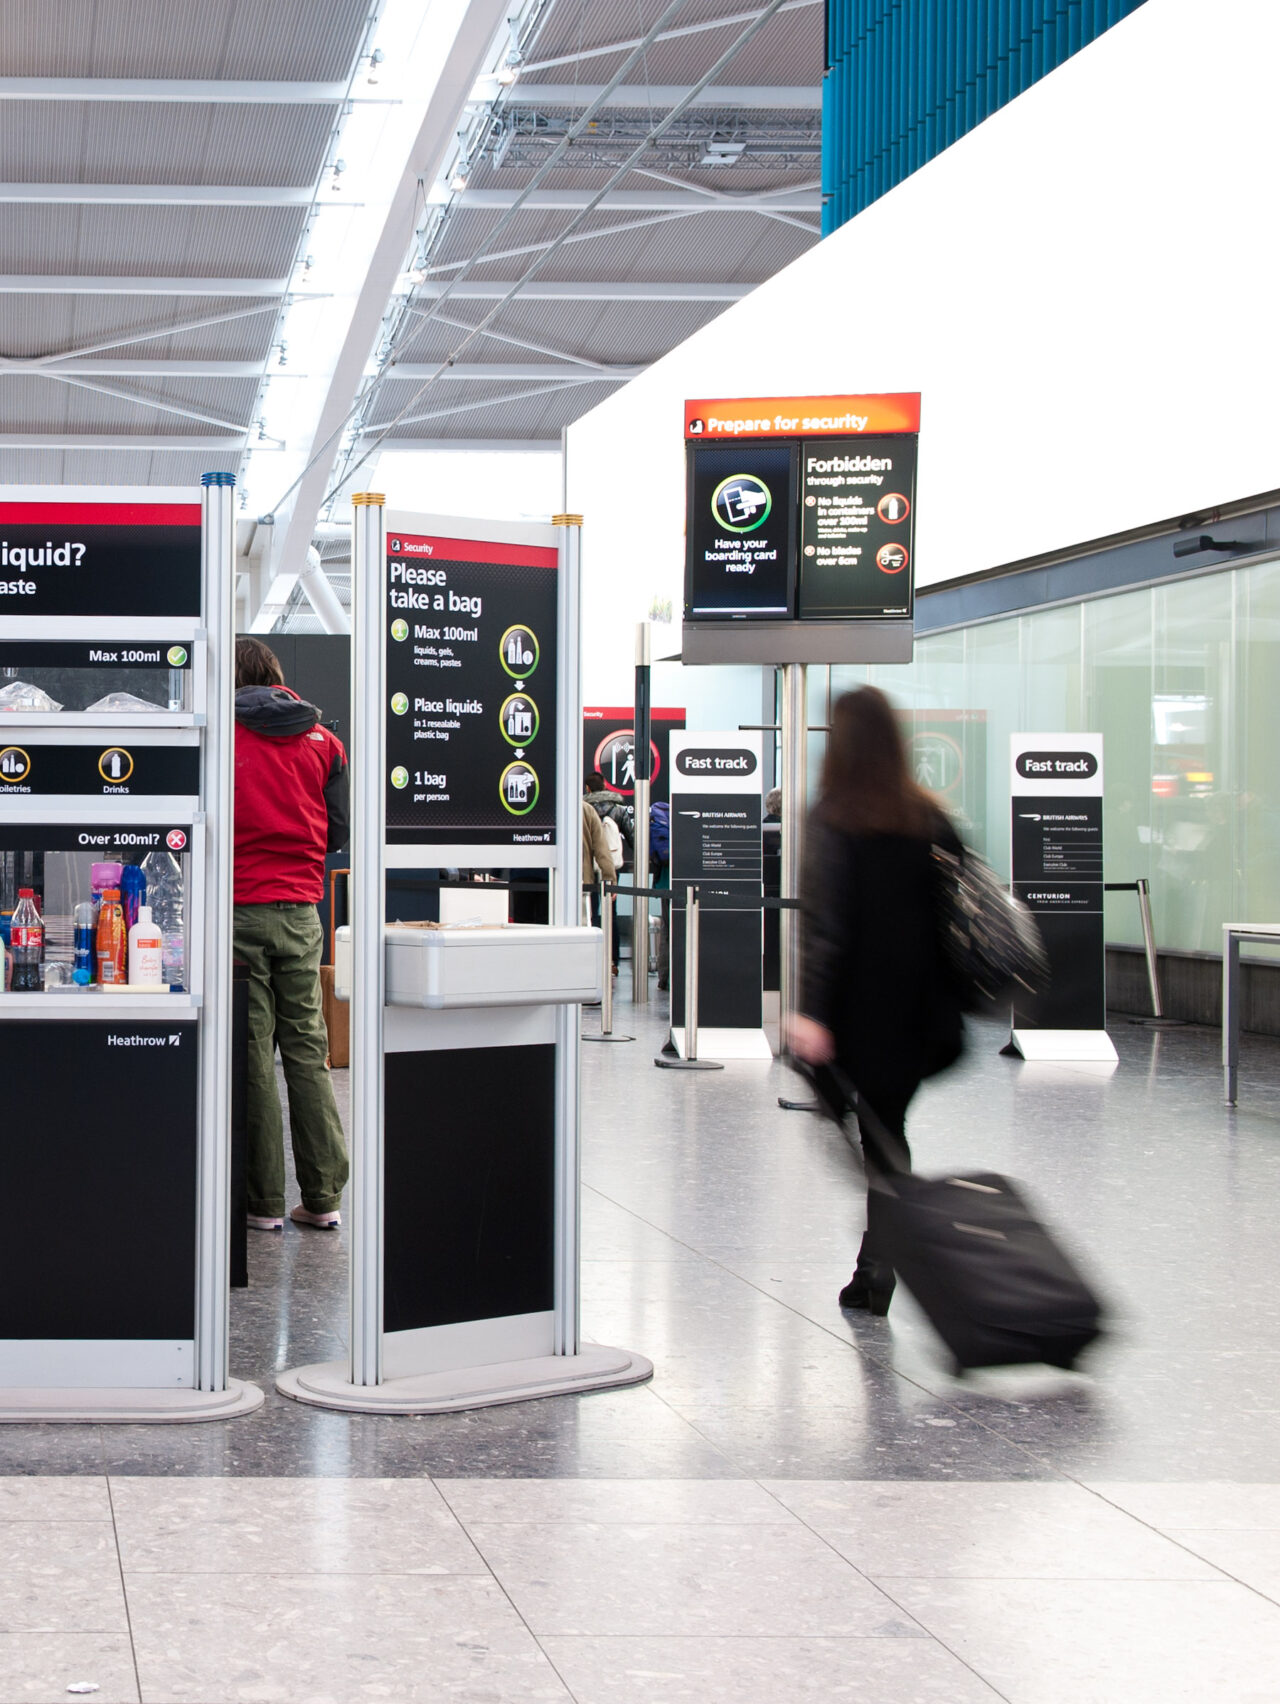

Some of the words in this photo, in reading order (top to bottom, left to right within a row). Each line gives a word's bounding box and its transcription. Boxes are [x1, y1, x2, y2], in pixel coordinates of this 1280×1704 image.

[708, 417, 771, 433] Prepare
[774, 415, 799, 430] for
[802, 414, 868, 431] security
[807, 456, 892, 472] Forbidden
[807, 476, 845, 487] through
[847, 475, 883, 485] security
[817, 497, 832, 506] No
[832, 496, 863, 507] liquids
[817, 507, 827, 516] in
[817, 518, 838, 526] over
[404, 543, 433, 555] Security
[715, 539, 741, 548] Have
[743, 540, 767, 551] your
[816, 547, 831, 555] No
[705, 551, 751, 562] boarding
[754, 550, 776, 560] card
[816, 557, 837, 565] over
[726, 562, 756, 573] ready
[390, 562, 446, 587] Please
[390, 588, 429, 610] take
[433, 593, 444, 611] a
[449, 590, 482, 617] bag
[415, 625, 440, 641] Max
[443, 625, 478, 642] 100ml
[89, 650, 118, 662] Max
[121, 649, 160, 662] 100ml
[414, 645, 437, 656] liquids,
[439, 647, 454, 658] gels,
[414, 657, 439, 668] creams,
[440, 658, 461, 668] pastes
[414, 698, 444, 714] Place
[446, 698, 483, 715] liquids
[414, 719, 421, 728] in
[422, 720, 426, 728] 1
[428, 720, 460, 729] resealable
[414, 730, 434, 740] plastic
[436, 730, 449, 741] bag
[685, 756, 711, 770] Fast
[714, 756, 747, 770] track
[1025, 759, 1052, 773] Fast
[1054, 759, 1088, 773] track
[414, 772, 422, 785] 1
[425, 772, 446, 787] bag
[103, 785, 129, 794] Drinks
[414, 793, 428, 802] per
[428, 793, 449, 802] person
[78, 834, 110, 845] Over
[113, 833, 160, 845] 100ml?
[513, 832, 543, 843] Heathrow
[108, 1034, 166, 1047] Heathrow
